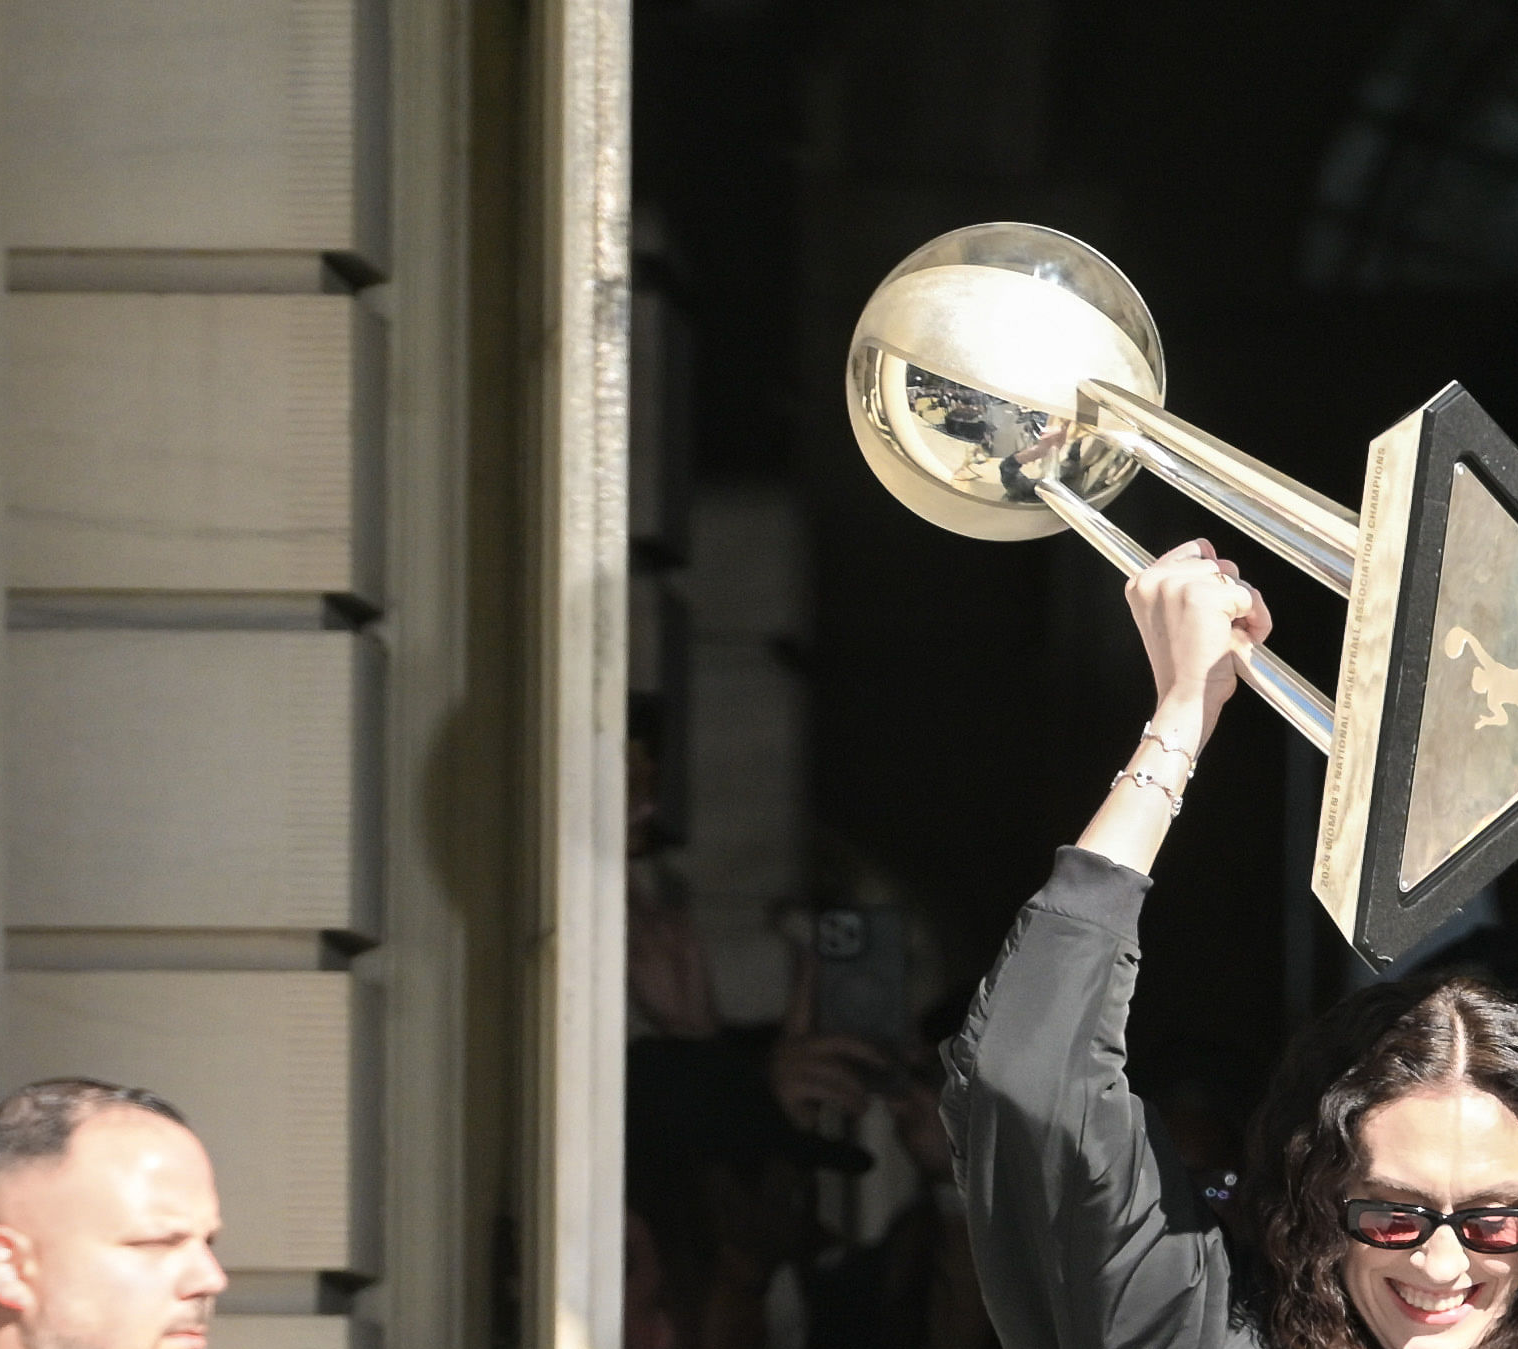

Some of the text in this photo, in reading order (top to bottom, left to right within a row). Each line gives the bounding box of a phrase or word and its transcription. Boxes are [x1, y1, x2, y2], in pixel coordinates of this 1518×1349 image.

[1319, 854, 1332, 888] 2024
[1334, 715, 1349, 780] NATIONAL
[1343, 626, 1361, 709] BASKETBALL
[1354, 532, 1374, 623] ASSOCIATION
[1368, 446, 1386, 528] CHAMPIONS
